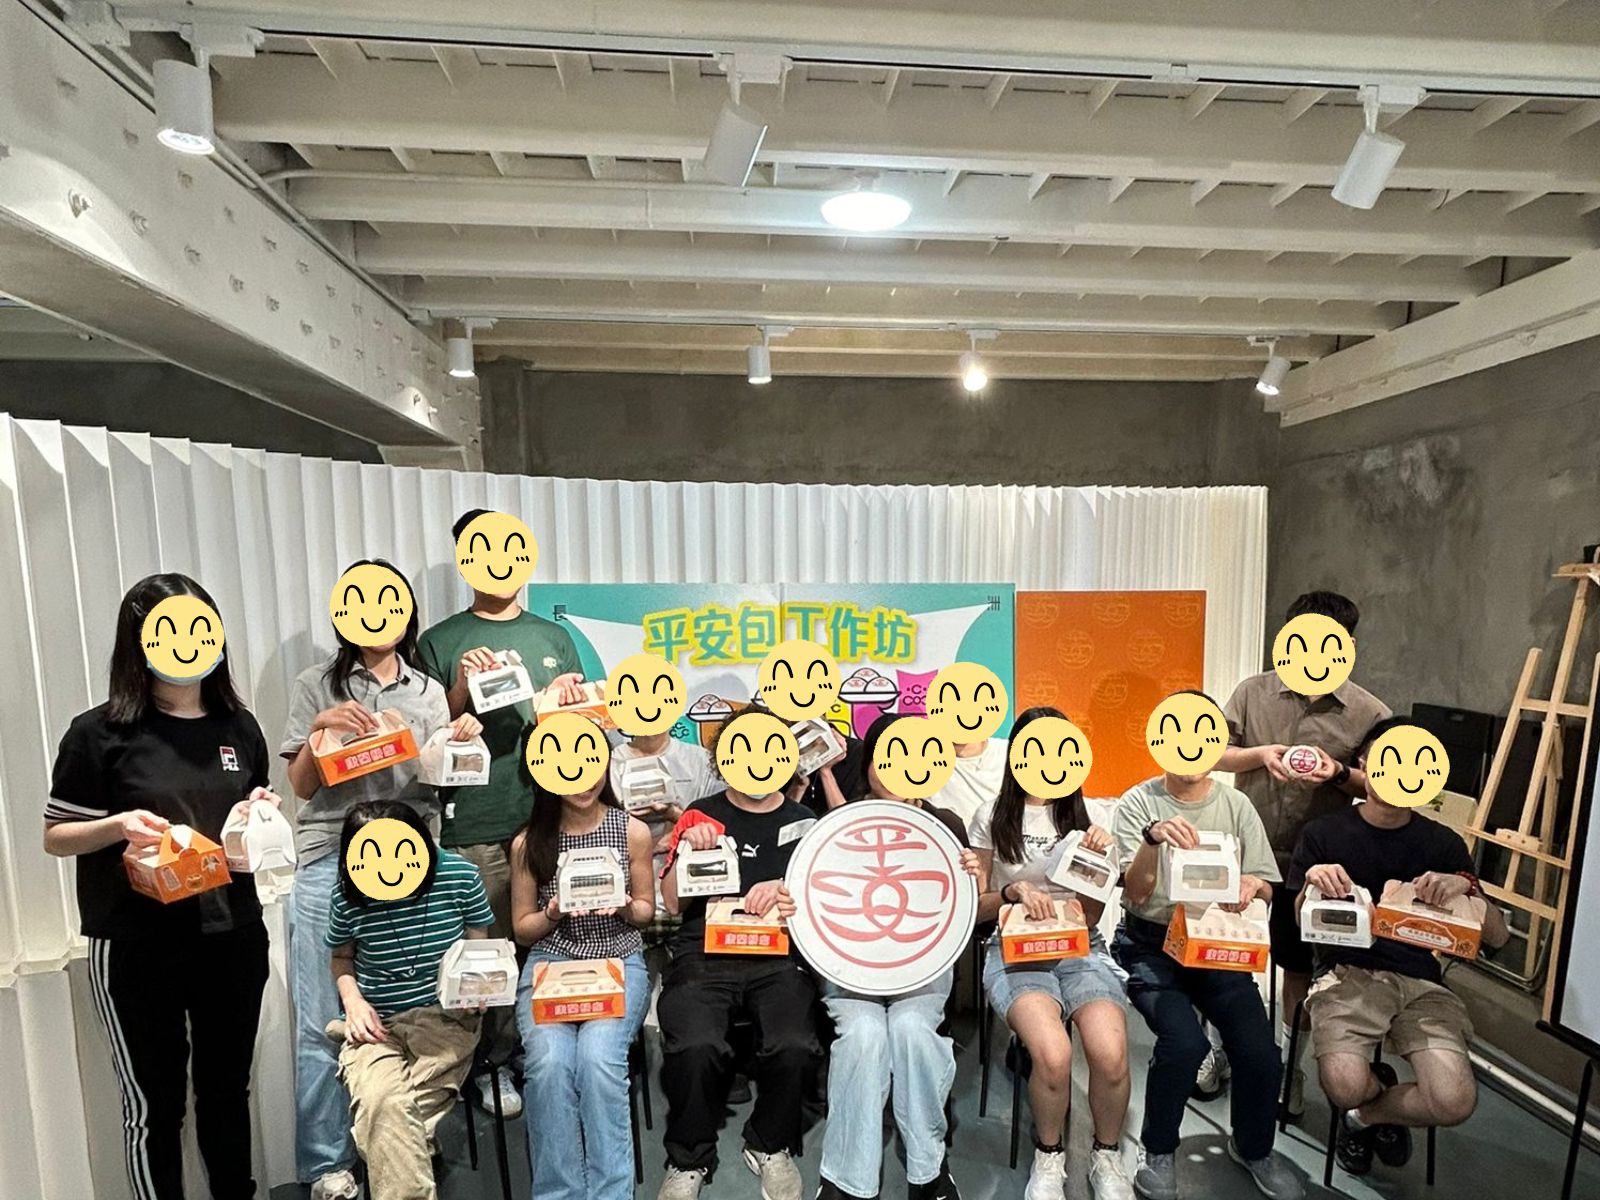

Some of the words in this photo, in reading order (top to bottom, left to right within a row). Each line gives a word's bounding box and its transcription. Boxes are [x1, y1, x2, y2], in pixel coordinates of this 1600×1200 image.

[645, 604, 914, 662] 平安包工作坊
